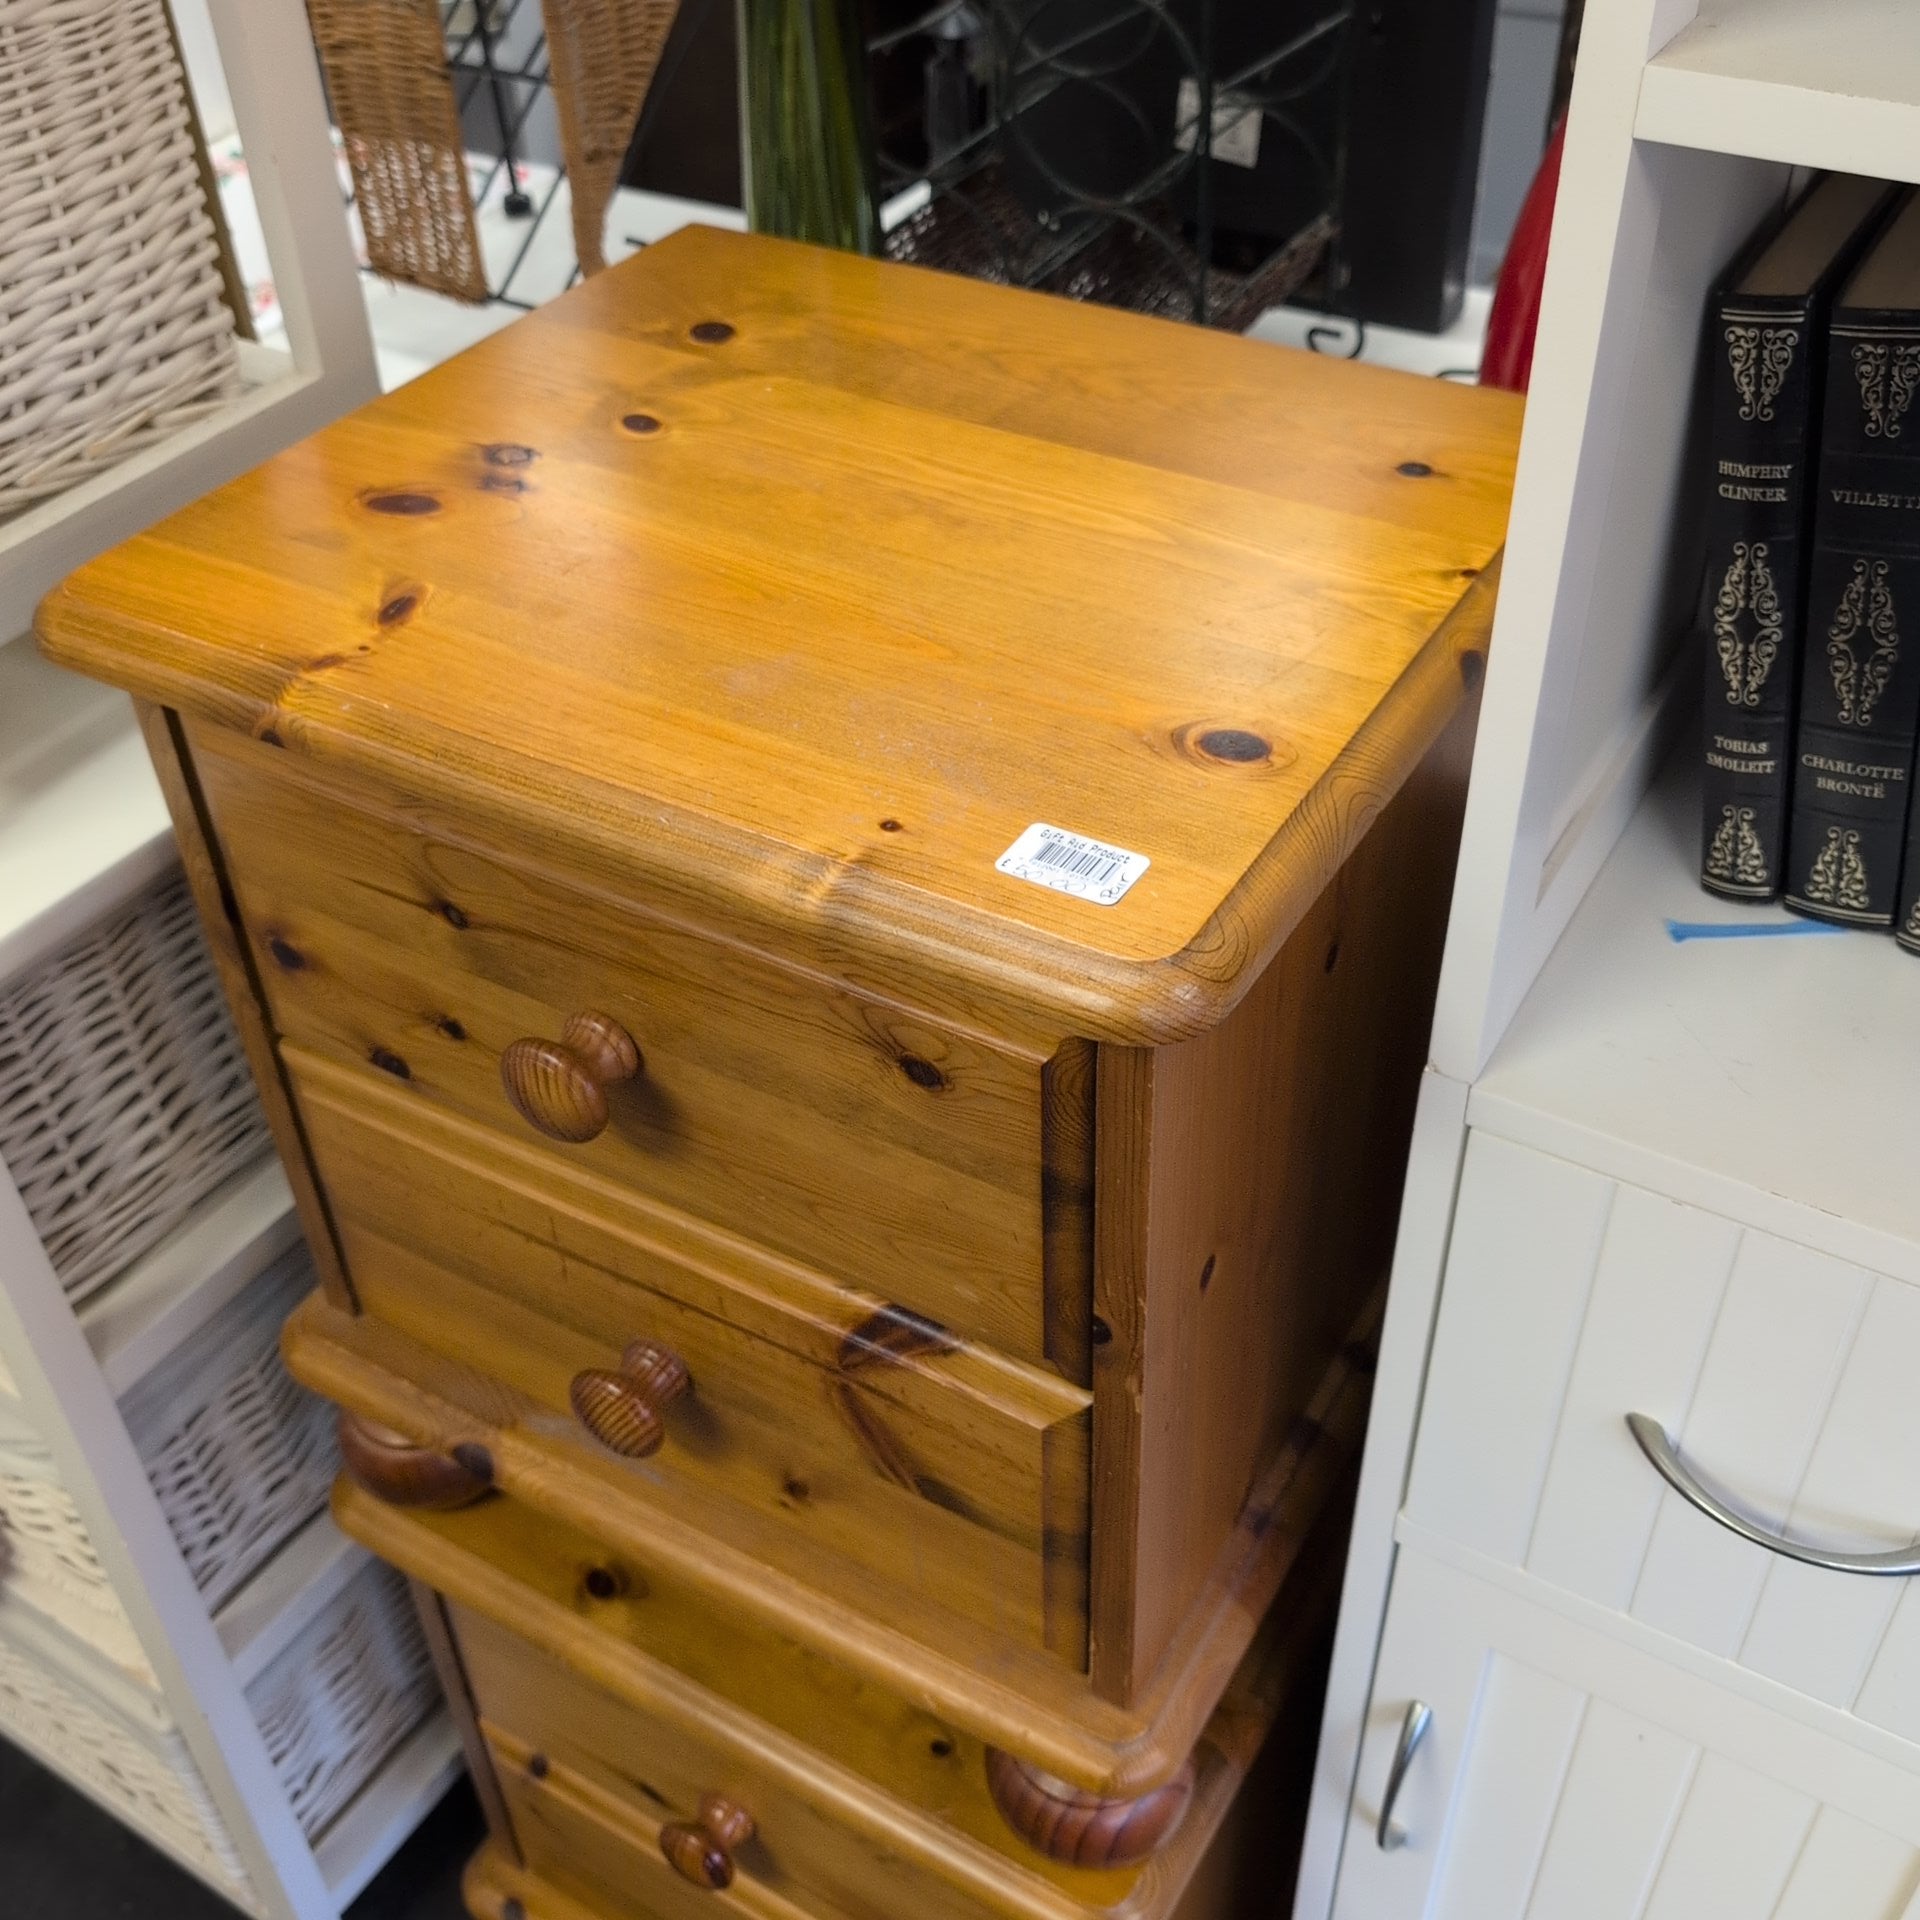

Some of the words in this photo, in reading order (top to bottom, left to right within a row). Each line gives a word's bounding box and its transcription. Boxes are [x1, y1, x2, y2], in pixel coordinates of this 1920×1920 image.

[1718, 460, 1792, 479] HUMPHRY
[1718, 483, 1787, 501] CLINKER
[1714, 735, 1769, 754] TOBIAS
[1706, 752, 1777, 774] SMOLLETT
[1801, 754, 1905, 780] CHARLOTTE
[1816, 776, 1885, 799] BRONTË
[1040, 829, 1065, 843] Gift
[1067, 838, 1088, 850] Aid
[1091, 844, 1131, 864] Product
